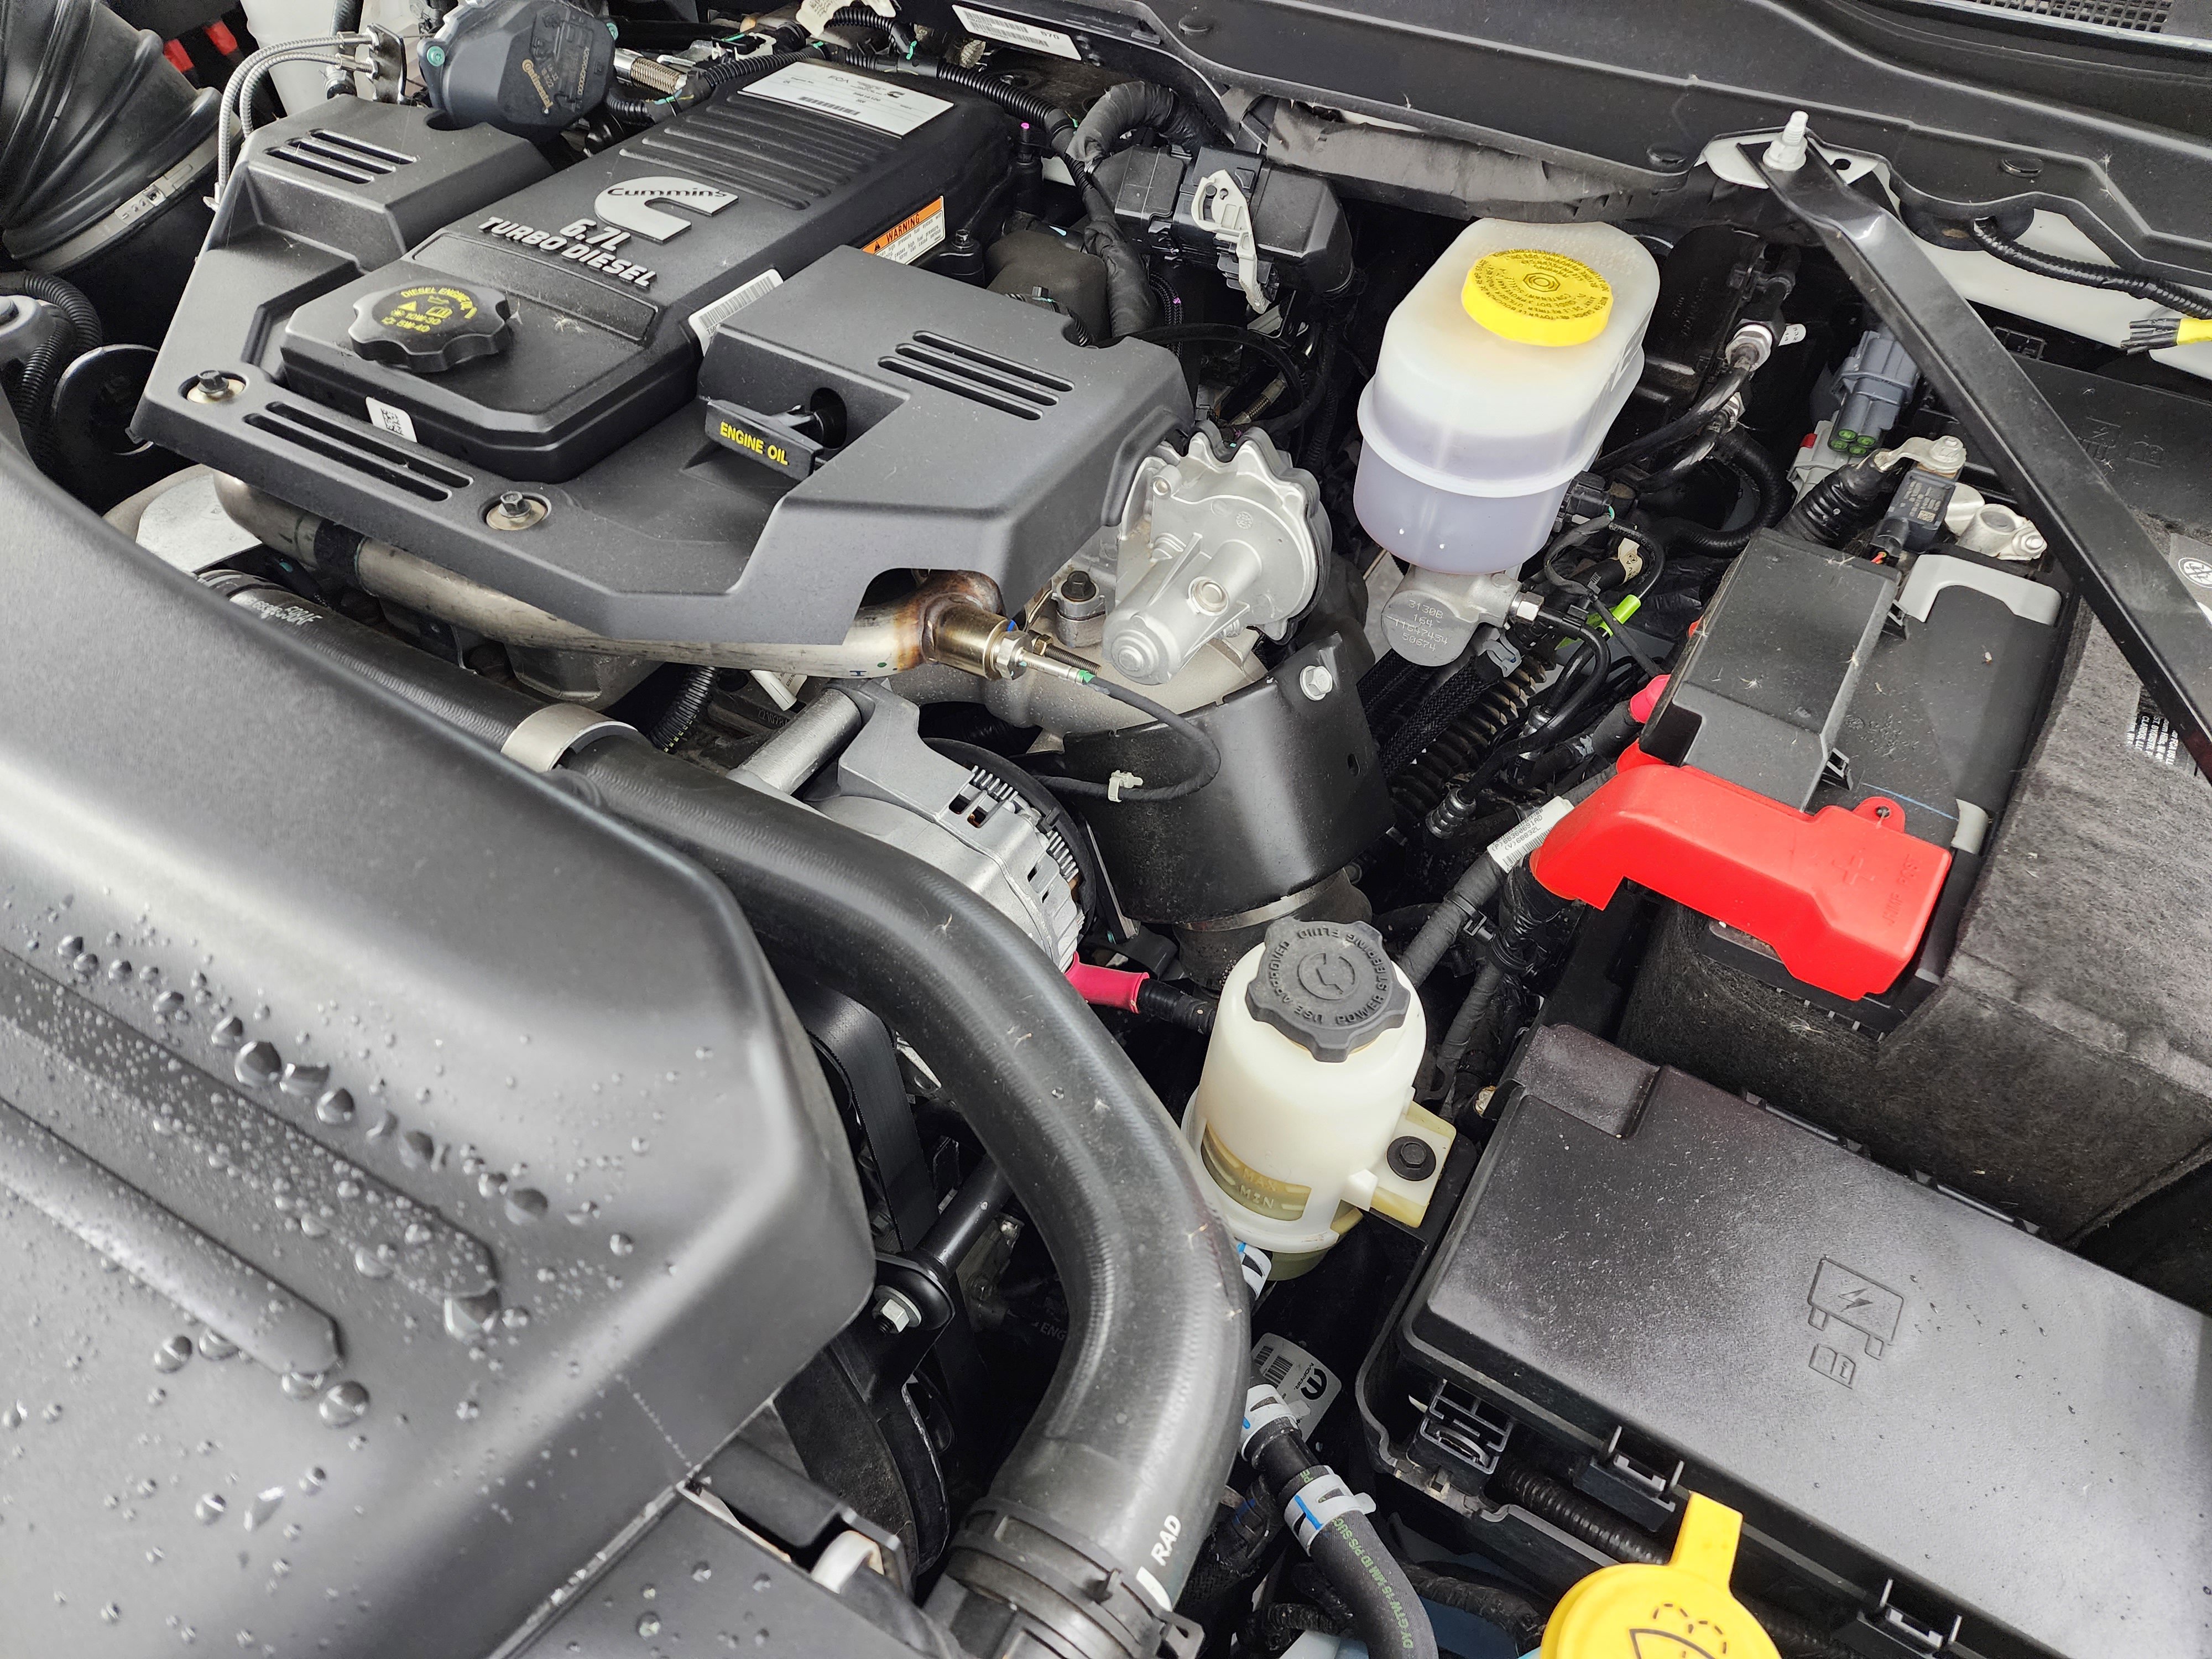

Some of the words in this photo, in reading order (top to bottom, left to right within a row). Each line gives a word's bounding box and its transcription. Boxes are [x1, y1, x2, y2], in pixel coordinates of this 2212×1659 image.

[522, 59, 554, 108] Continental
[608, 187, 728, 197] Cummins
[559, 217, 632, 252] 6.7L
[886, 213, 920, 243] WARNING
[477, 216, 568, 252] TURBO
[561, 242, 658, 288] DIESEL
[400, 286, 436, 299] DIESEL
[720, 421, 764, 455] ENGINE
[767, 445, 789, 466] OIL
[1402, 632, 1436, 651] 50674
[2135, 716, 2150, 740] CLARIOS,
[1269, 941, 1294, 1004] APPROVED
[1346, 933, 1389, 992] STEERING
[1294, 1005, 1324, 1025] USE
[1336, 994, 1384, 1025] POWER
[1243, 1167, 1276, 1191] MAX
[1239, 1185, 1274, 1208] MIN
[1040, 1322, 1067, 1340] ENG
[1151, 1515, 1181, 1566] RAD
[1332, 1517, 1353, 1540] SUC
[1369, 1566, 1387, 1586] MM
[1390, 1600, 1409, 1629] GTW
[1401, 1631, 1413, 1648] DY
